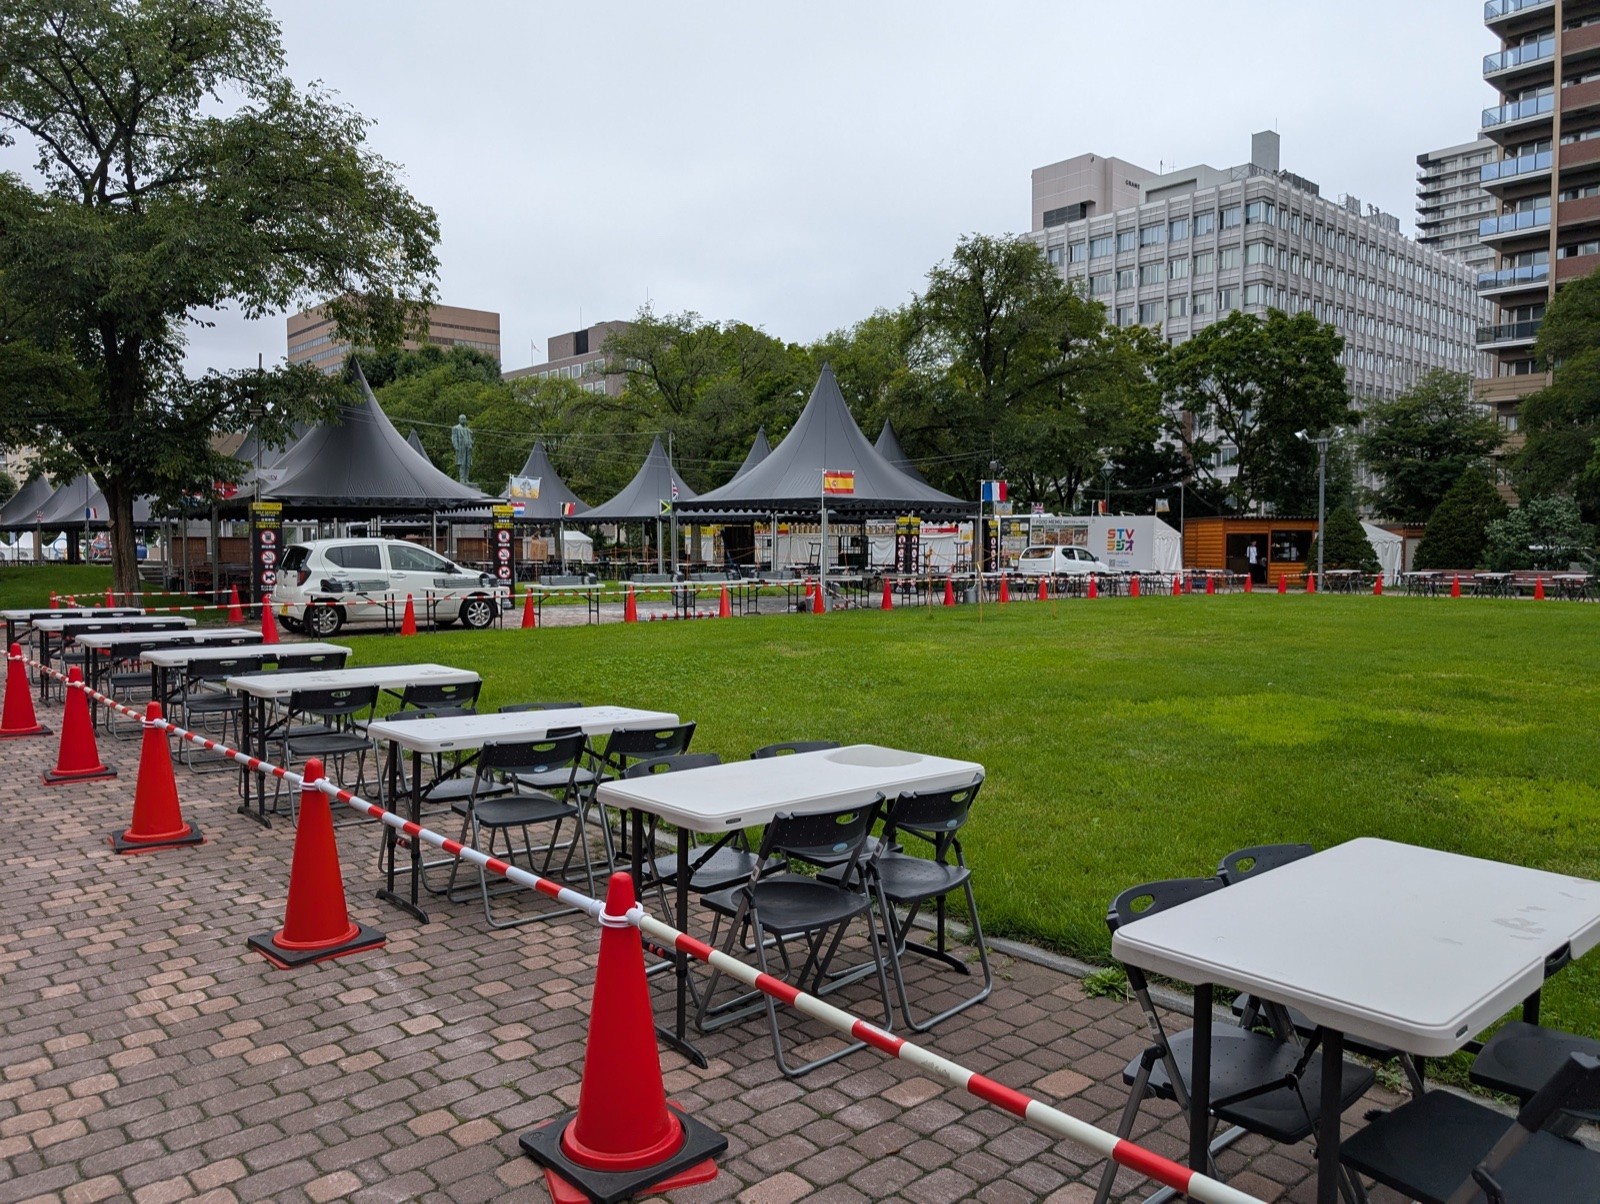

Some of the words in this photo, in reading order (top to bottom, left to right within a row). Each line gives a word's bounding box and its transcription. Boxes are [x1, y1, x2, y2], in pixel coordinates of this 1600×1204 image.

[1107, 528, 1135, 539] STV
[1107, 539, 1134, 551] ラジオ
